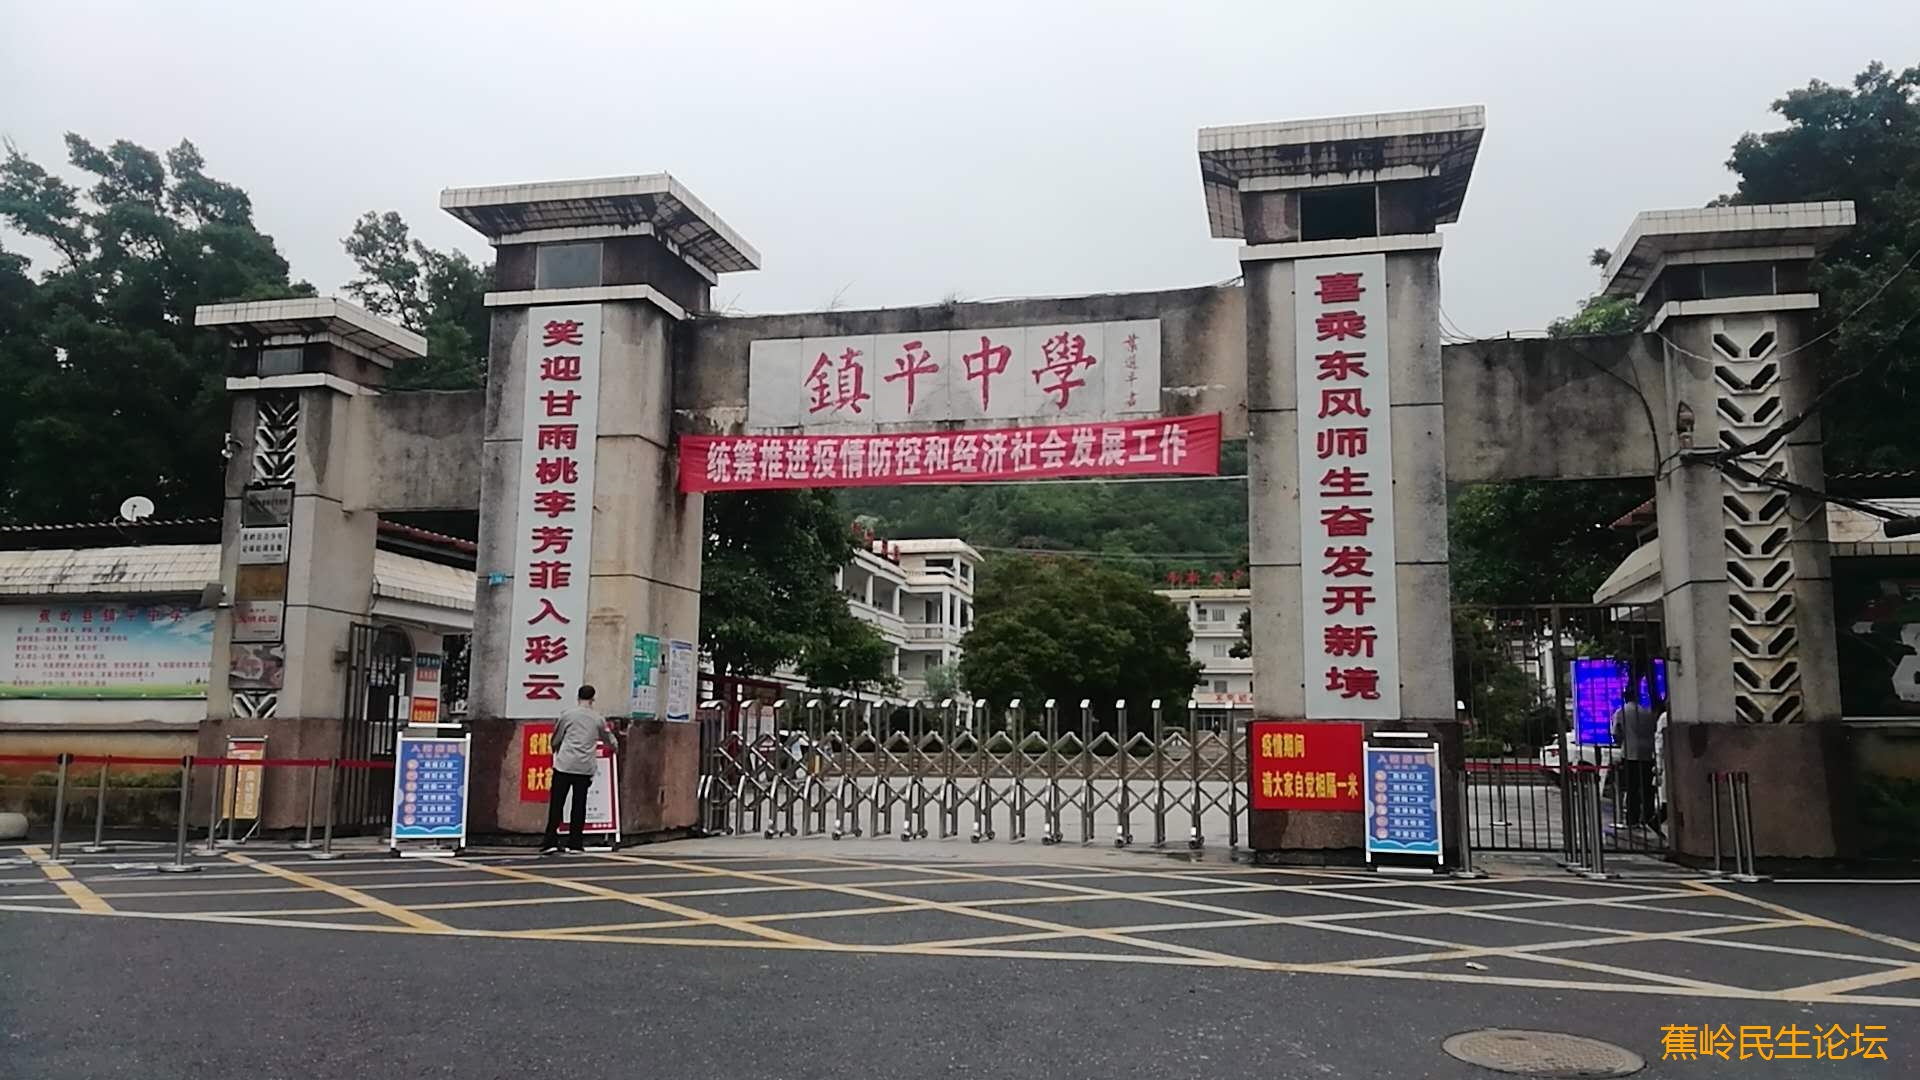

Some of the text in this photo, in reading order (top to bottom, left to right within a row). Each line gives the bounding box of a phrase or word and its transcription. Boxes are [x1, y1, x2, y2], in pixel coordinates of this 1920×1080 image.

[804, 331, 1097, 415] 鎮平中學
[706, 424, 1188, 484] 统筹推进疫情防控和经济社会发展工作
[1313, 271, 1381, 700] 喜乘东风师生奋发开新境
[522, 319, 584, 701] 笑迎甘雨桃李芳菲入彩云
[1262, 733, 1305, 758] 疫情期间
[1262, 770, 1358, 799] 请大家自觉相隔一米
